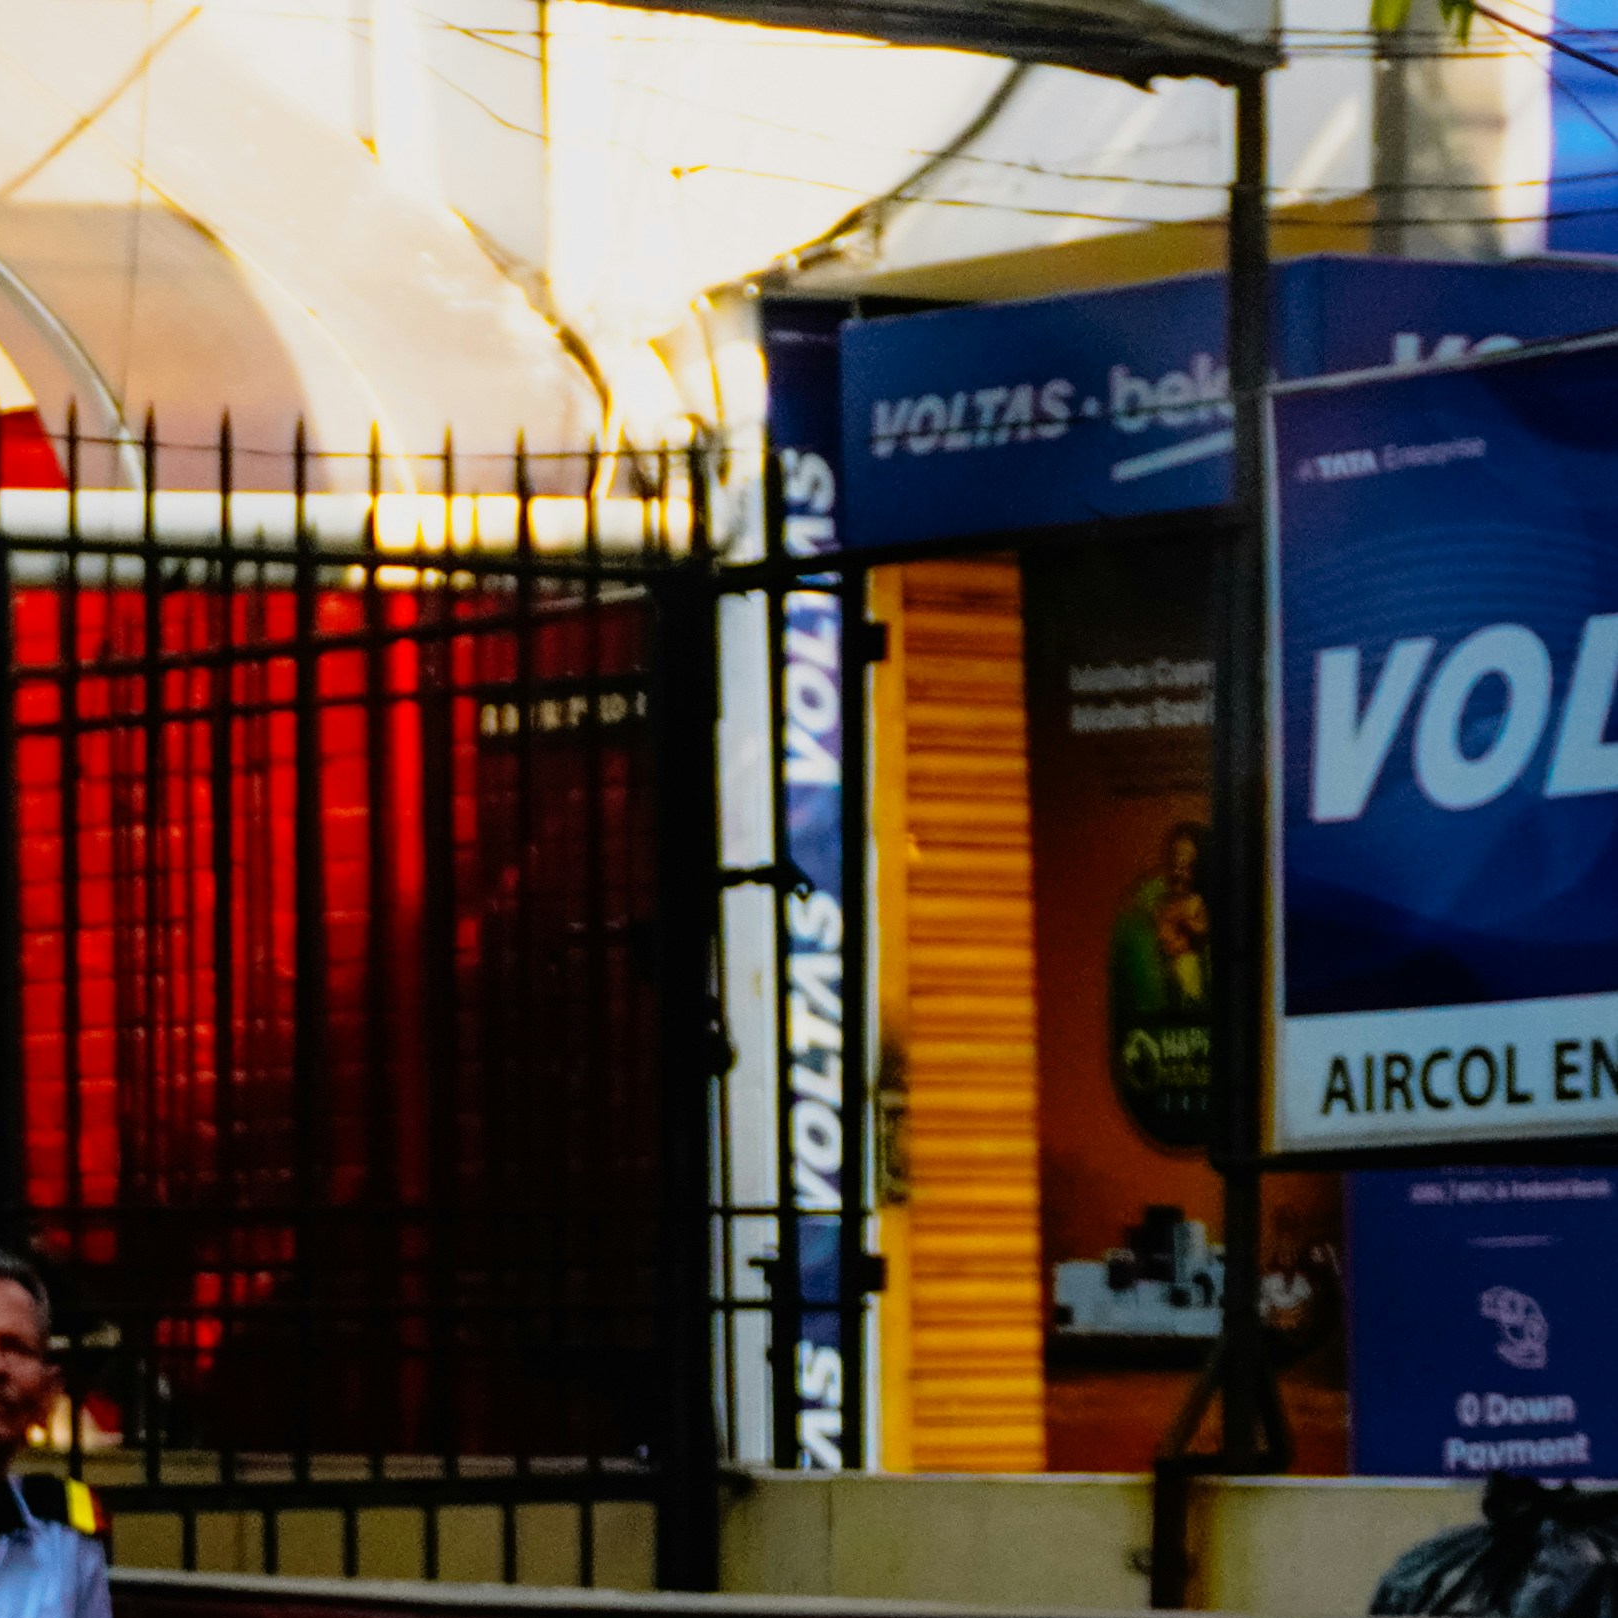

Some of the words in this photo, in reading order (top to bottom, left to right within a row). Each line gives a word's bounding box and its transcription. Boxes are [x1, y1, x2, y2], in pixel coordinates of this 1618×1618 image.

[869, 377, 1071, 458] VOLTAS
[1109, 351, 1233, 433] bek
[1309, 613, 1618, 825] VOL
[785, 889, 843, 1209] VOLTAS
[1321, 1043, 1533, 1115] AIRCOL
[1443, 1432, 1592, 1471] Payment
[1483, 1392, 1577, 1426] Down
